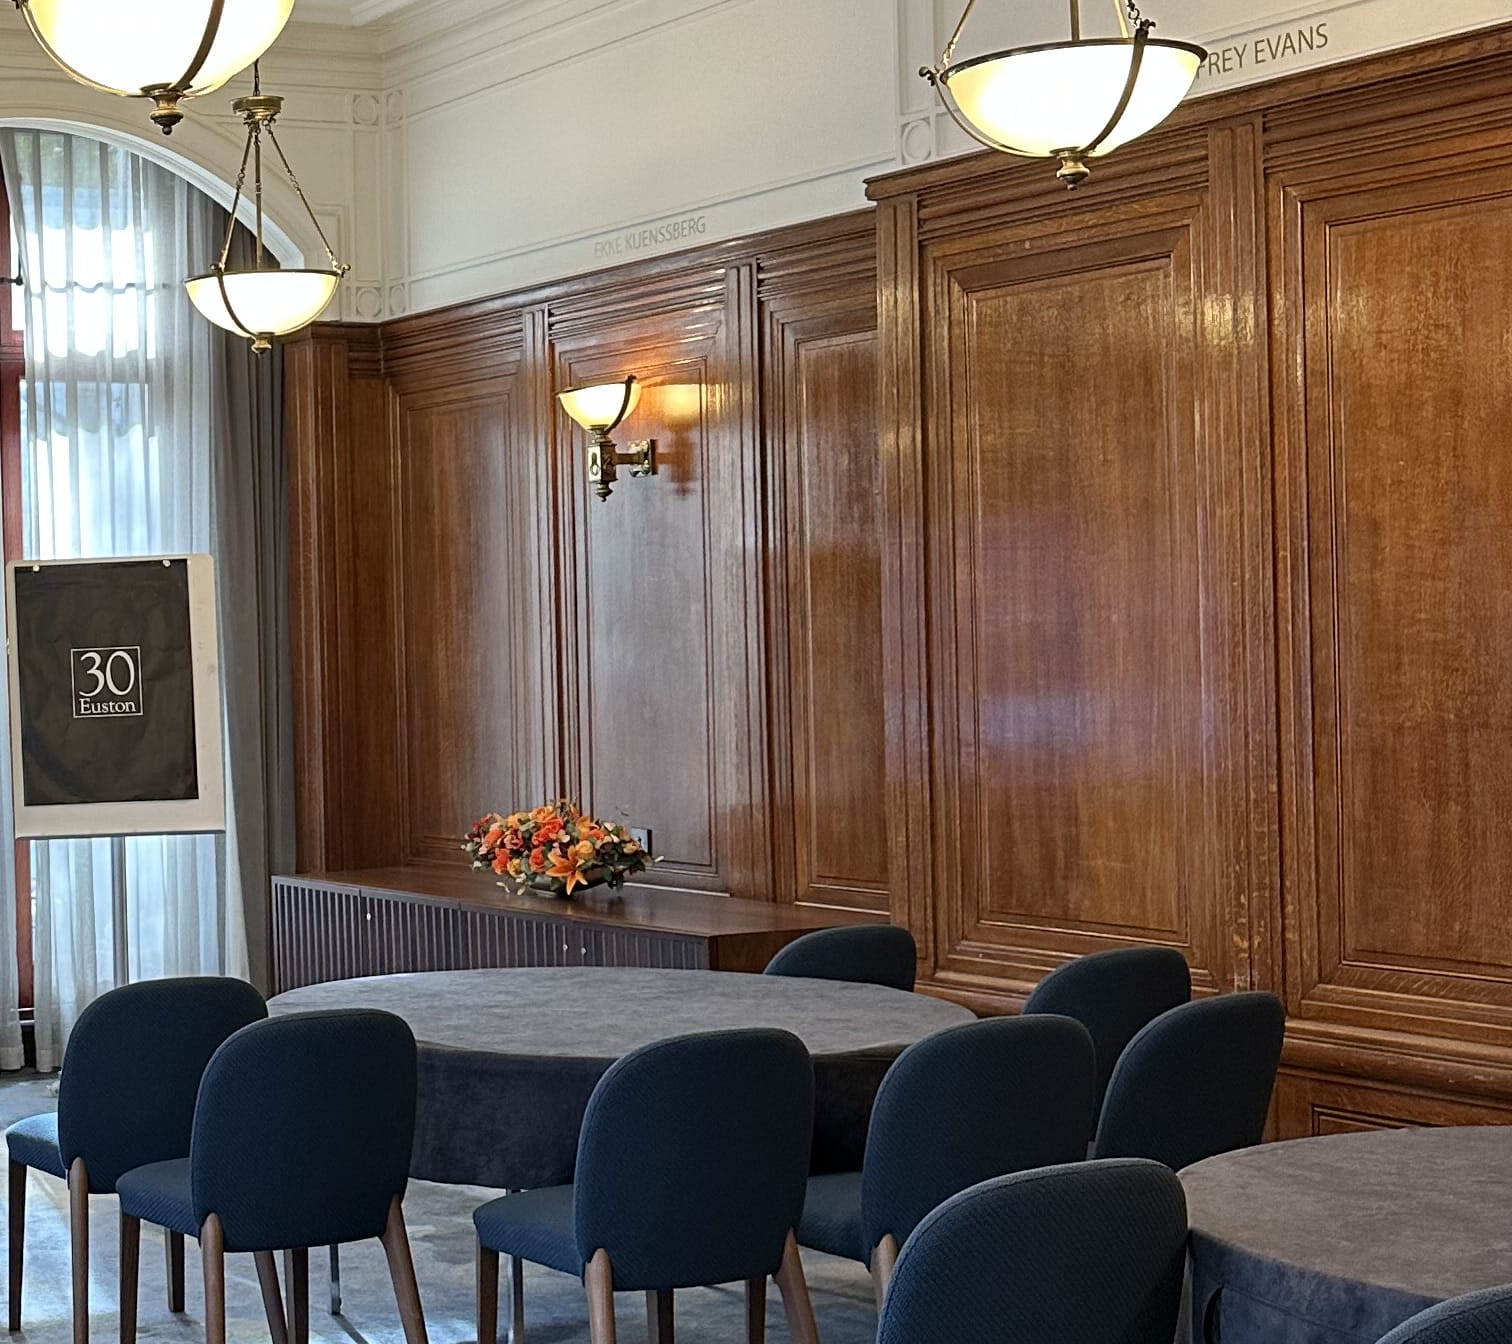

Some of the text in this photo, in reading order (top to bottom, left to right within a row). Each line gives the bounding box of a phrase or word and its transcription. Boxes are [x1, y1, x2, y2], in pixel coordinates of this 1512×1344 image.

[1254, 23, 1328, 64] EVANS
[625, 216, 706, 249] KUENSSBERG
[79, 650, 135, 697] 30
[80, 698, 136, 714] Euston
